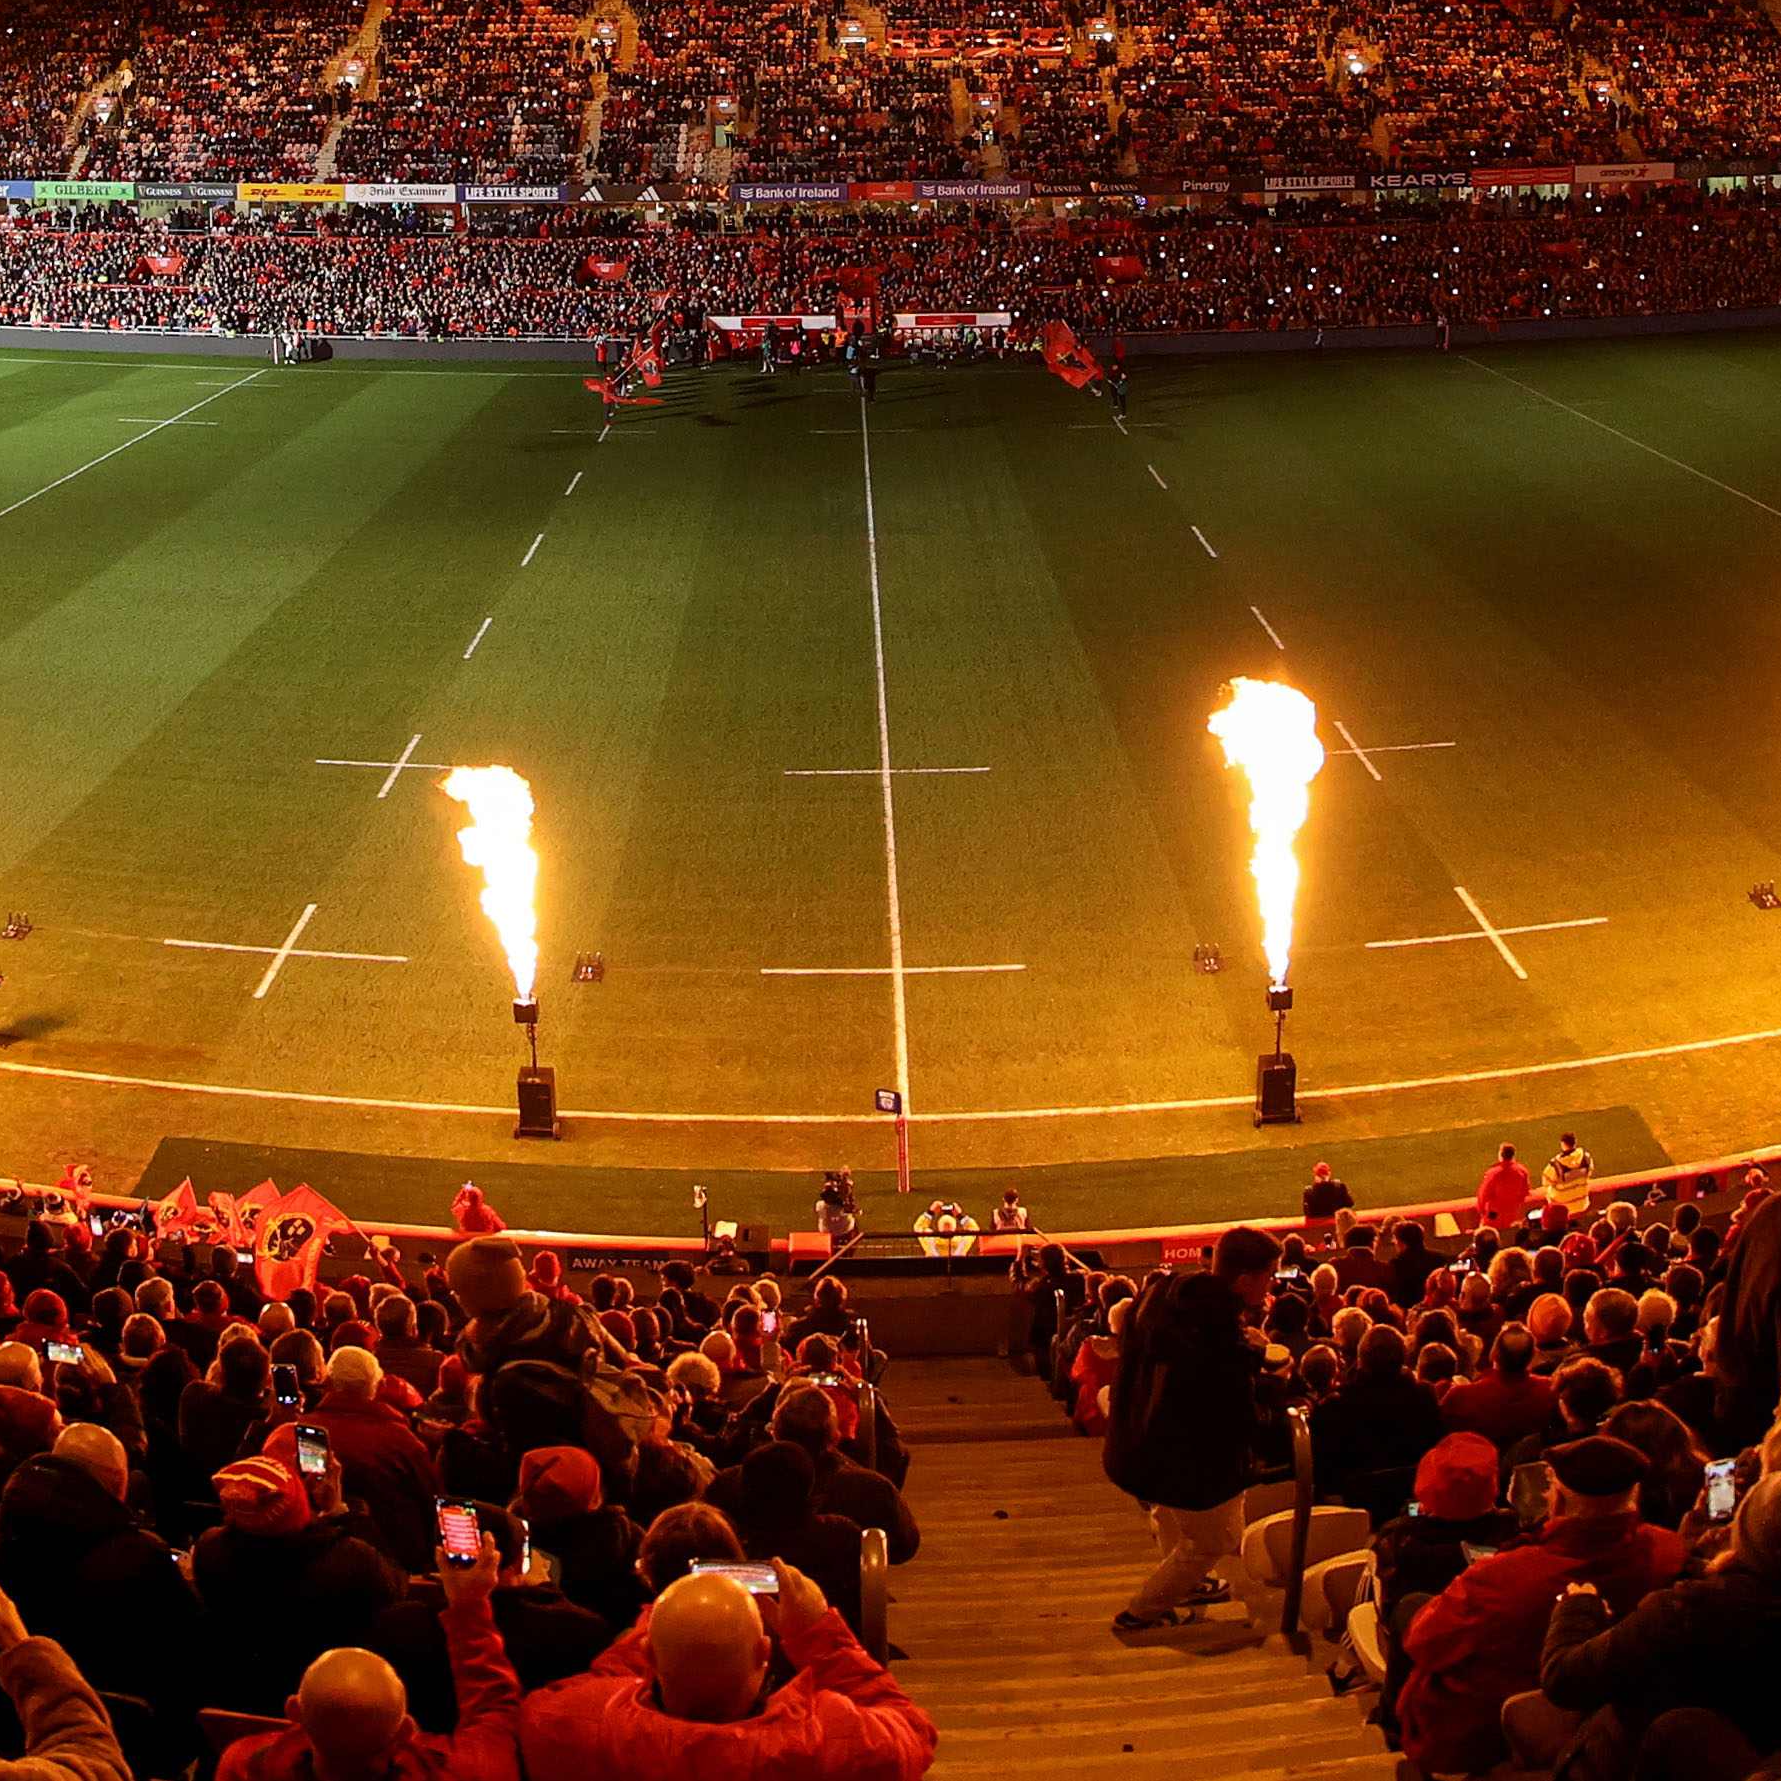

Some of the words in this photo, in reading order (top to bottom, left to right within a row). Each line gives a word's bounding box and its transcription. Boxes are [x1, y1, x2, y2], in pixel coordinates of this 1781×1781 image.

[1264, 176, 1285, 187] LIFE
[1286, 176, 1317, 187] STYLE
[1318, 175, 1356, 187] SPORTS
[1370, 172, 1467, 188] KEARYS
[54, 185, 112, 196] GILBERT
[146, 187, 182, 197] GUINNESS
[197, 187, 234, 197] GUINNESS
[249, 188, 279, 196] DHL
[369, 186, 395, 197] Irish
[399, 186, 448, 197] Examiner
[937, 185, 966, 196] Bank
[967, 184, 979, 195] of
[980, 183, 1020, 196] Ireland
[1042, 184, 1082, 193] GUINNESS
[1099, 183, 1138, 192] GUINNESS
[1182, 180, 1230, 193] Pinergy
[304, 188, 333, 197] DHL
[466, 187, 486, 198] LIFE
[487, 187, 518, 198] STYLE
[519, 187, 559, 198] SPORTS
[755, 187, 784, 199] Bank
[785, 186, 797, 199] of
[798, 187, 840, 199] Ireland
[1164, 1246, 1202, 1260] HOM
[572, 1257, 618, 1269] AWAY
